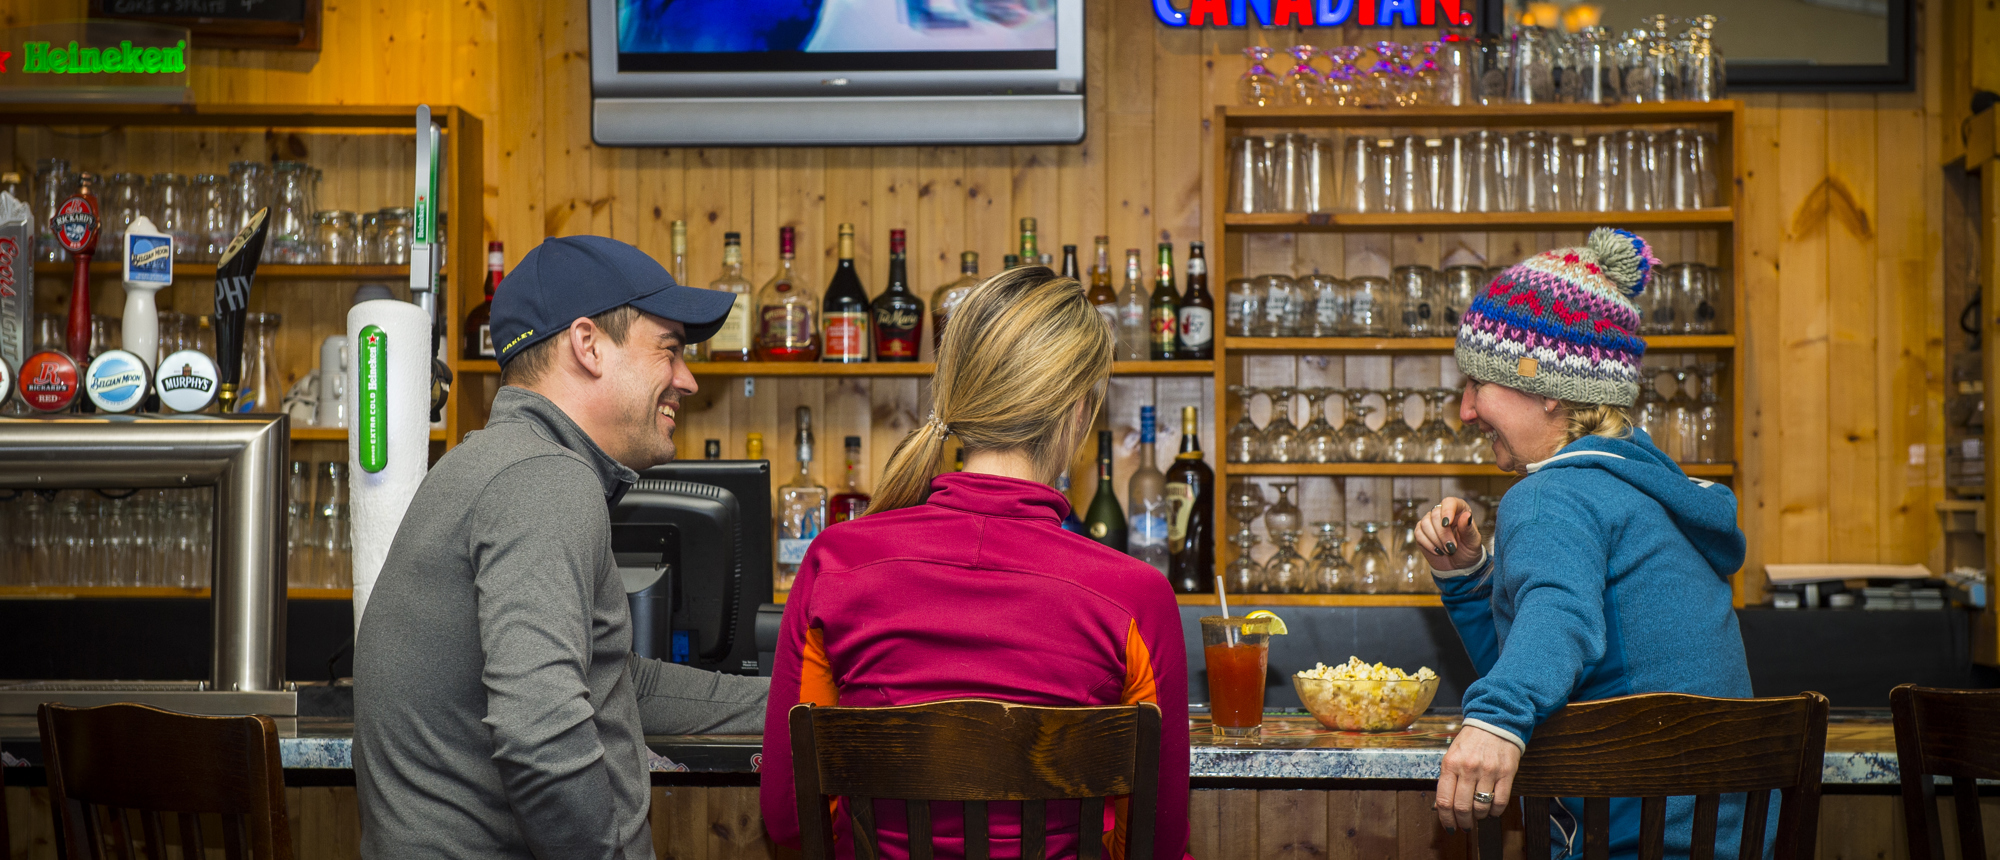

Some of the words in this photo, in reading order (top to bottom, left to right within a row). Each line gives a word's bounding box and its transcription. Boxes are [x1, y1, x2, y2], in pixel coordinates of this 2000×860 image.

[23, 40, 186, 74] Heineken
[0, 235, 19, 298] Coors
[1, 300, 18, 363] LIGHT
[502, 329, 534, 354] OAKLEY
[91, 376, 121, 390] BELGIAN
[122, 374, 141, 384] MOON
[367, 345, 378, 391] Heineken
